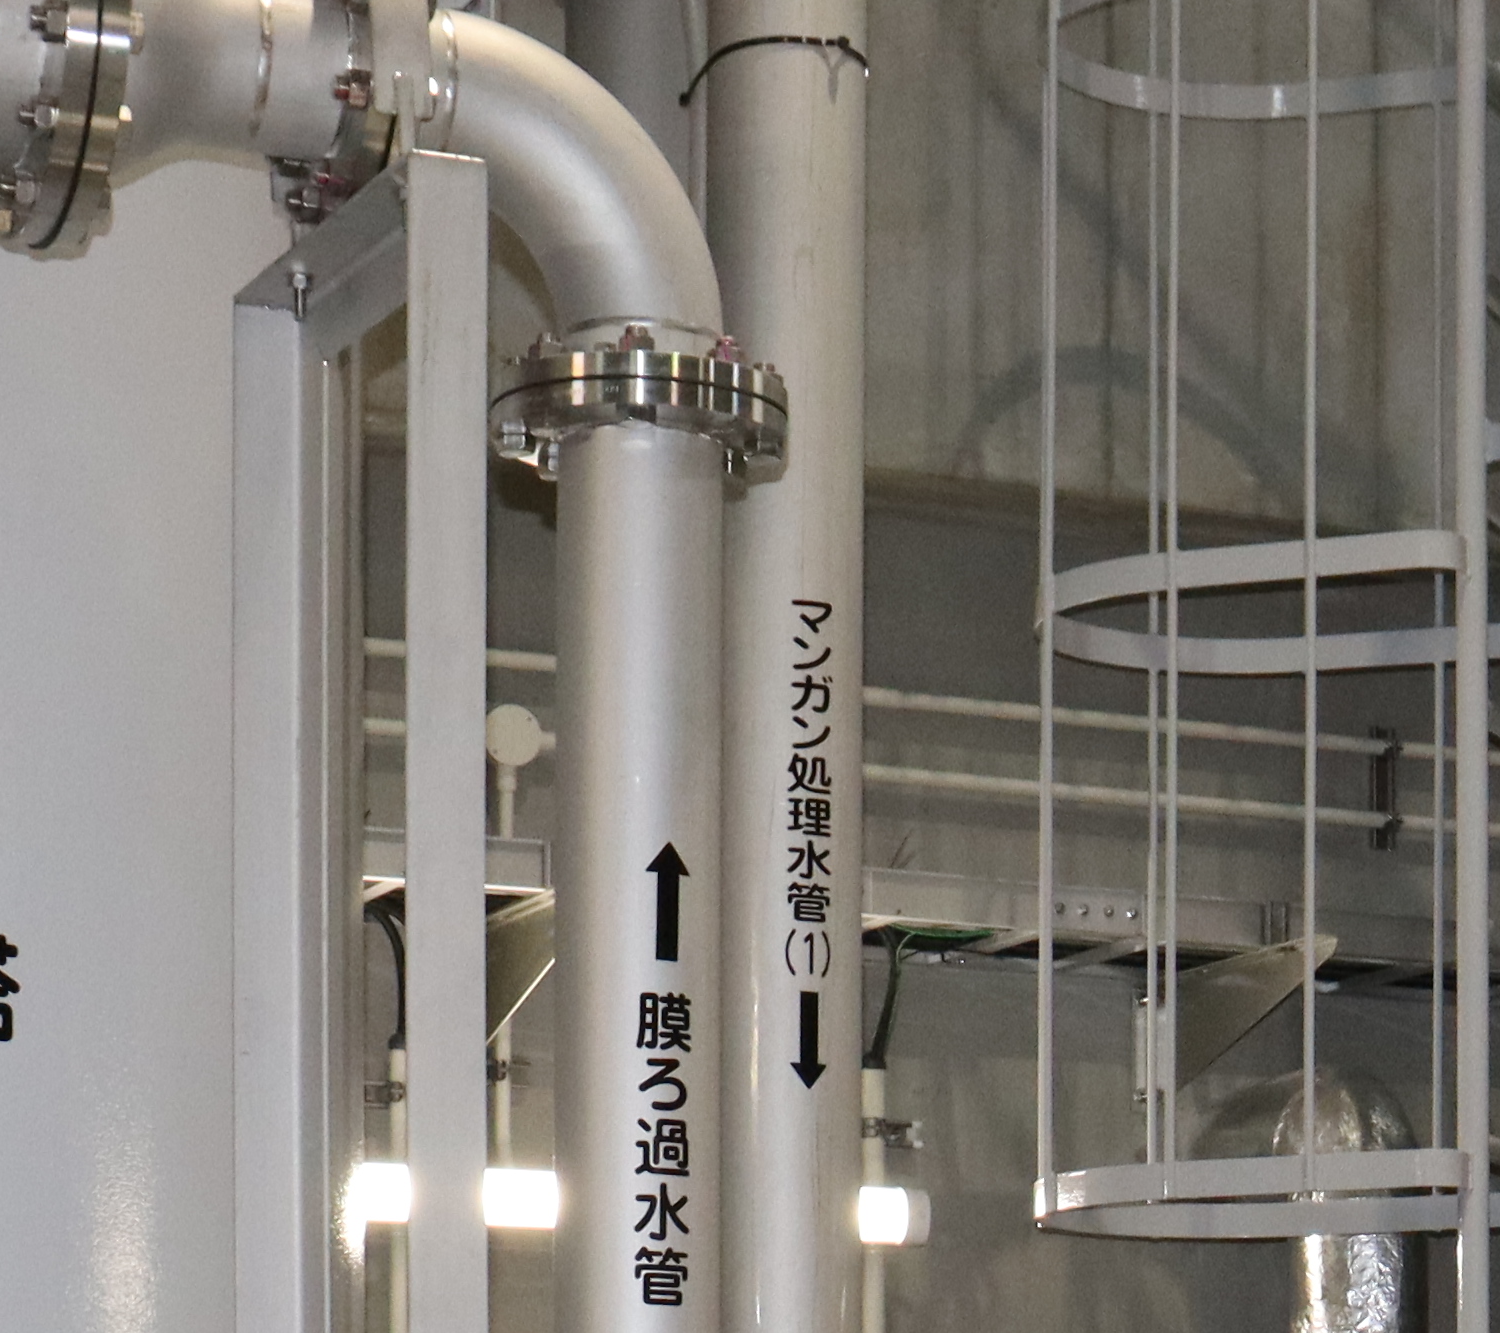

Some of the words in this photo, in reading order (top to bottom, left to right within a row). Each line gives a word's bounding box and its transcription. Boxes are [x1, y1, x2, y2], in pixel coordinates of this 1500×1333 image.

[785, 599, 832, 978] マンガン処理水管(1)
[635, 992, 692, 1307] 膜ろ過水管
